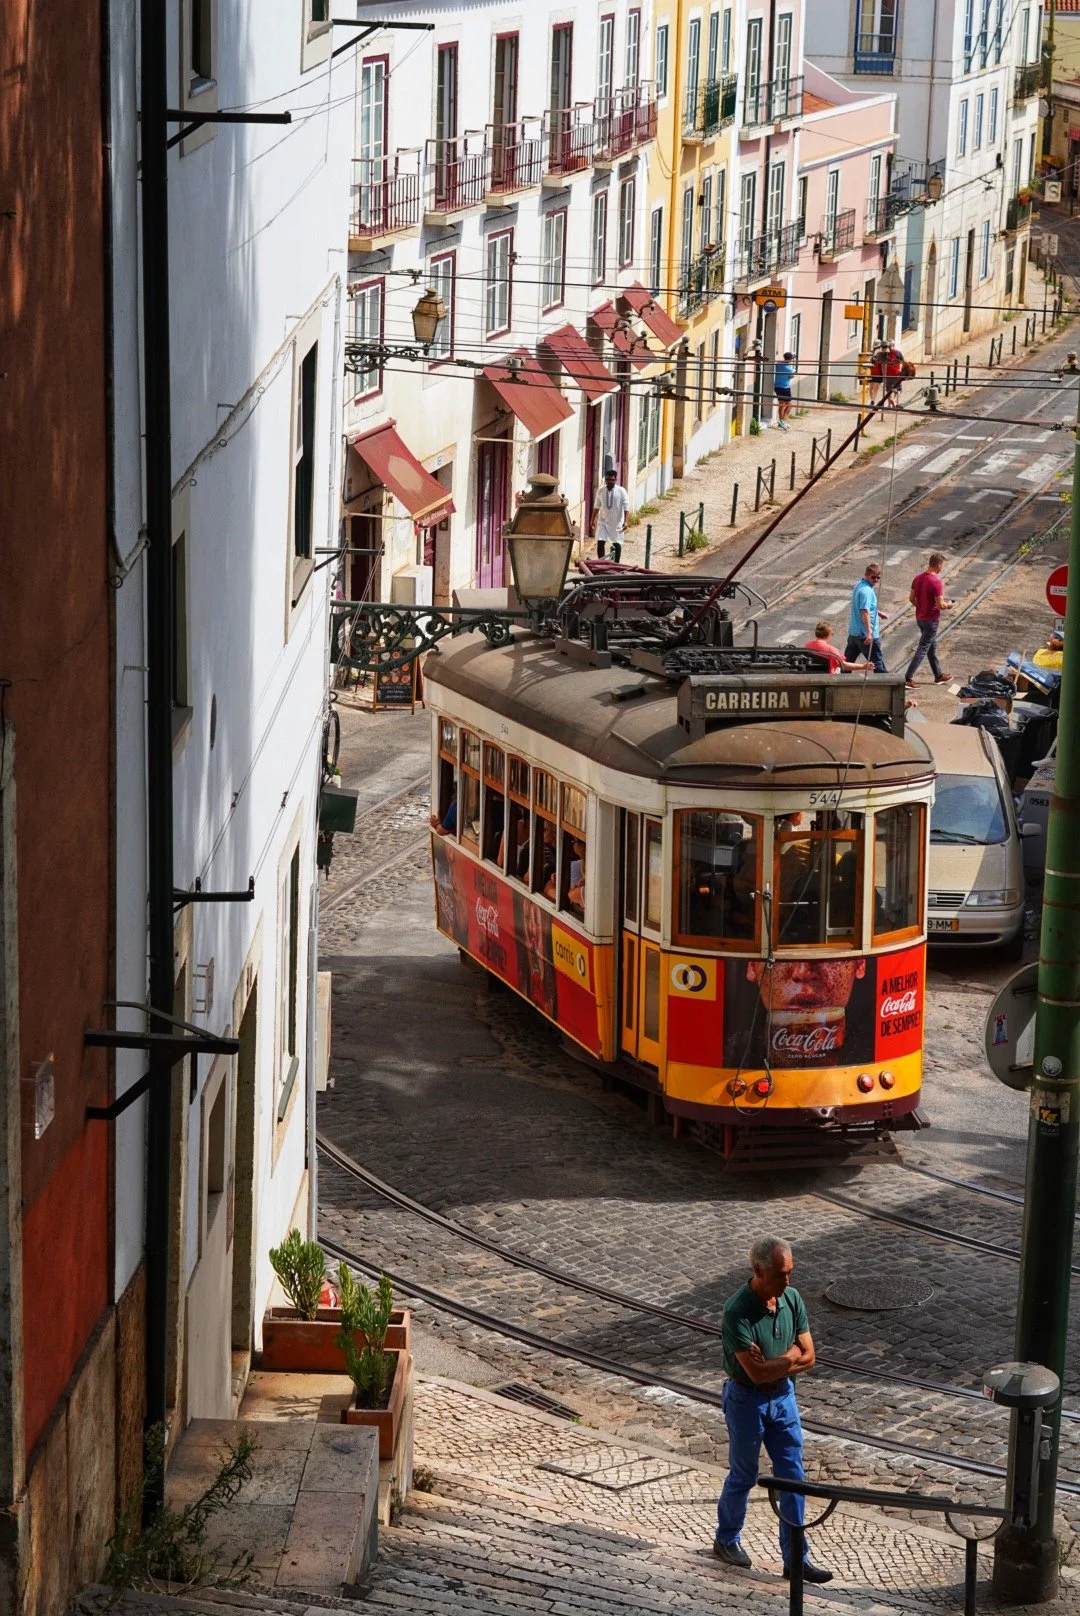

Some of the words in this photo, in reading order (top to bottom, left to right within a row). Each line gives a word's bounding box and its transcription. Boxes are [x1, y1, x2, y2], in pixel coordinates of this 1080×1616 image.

[761, 289, 782, 297] ATM
[706, 691, 790, 710] CARREIRA
[799, 690, 820, 709] Nº
[809, 793, 838, 805] 544
[475, 896, 500, 938] Coca-Cola
[881, 979, 889, 996] A
[889, 971, 918, 994] MELHOR
[880, 989, 918, 1018] Coca-Cola
[772, 1024, 840, 1053] Coca-Cola
[880, 1019, 893, 1037] DE
